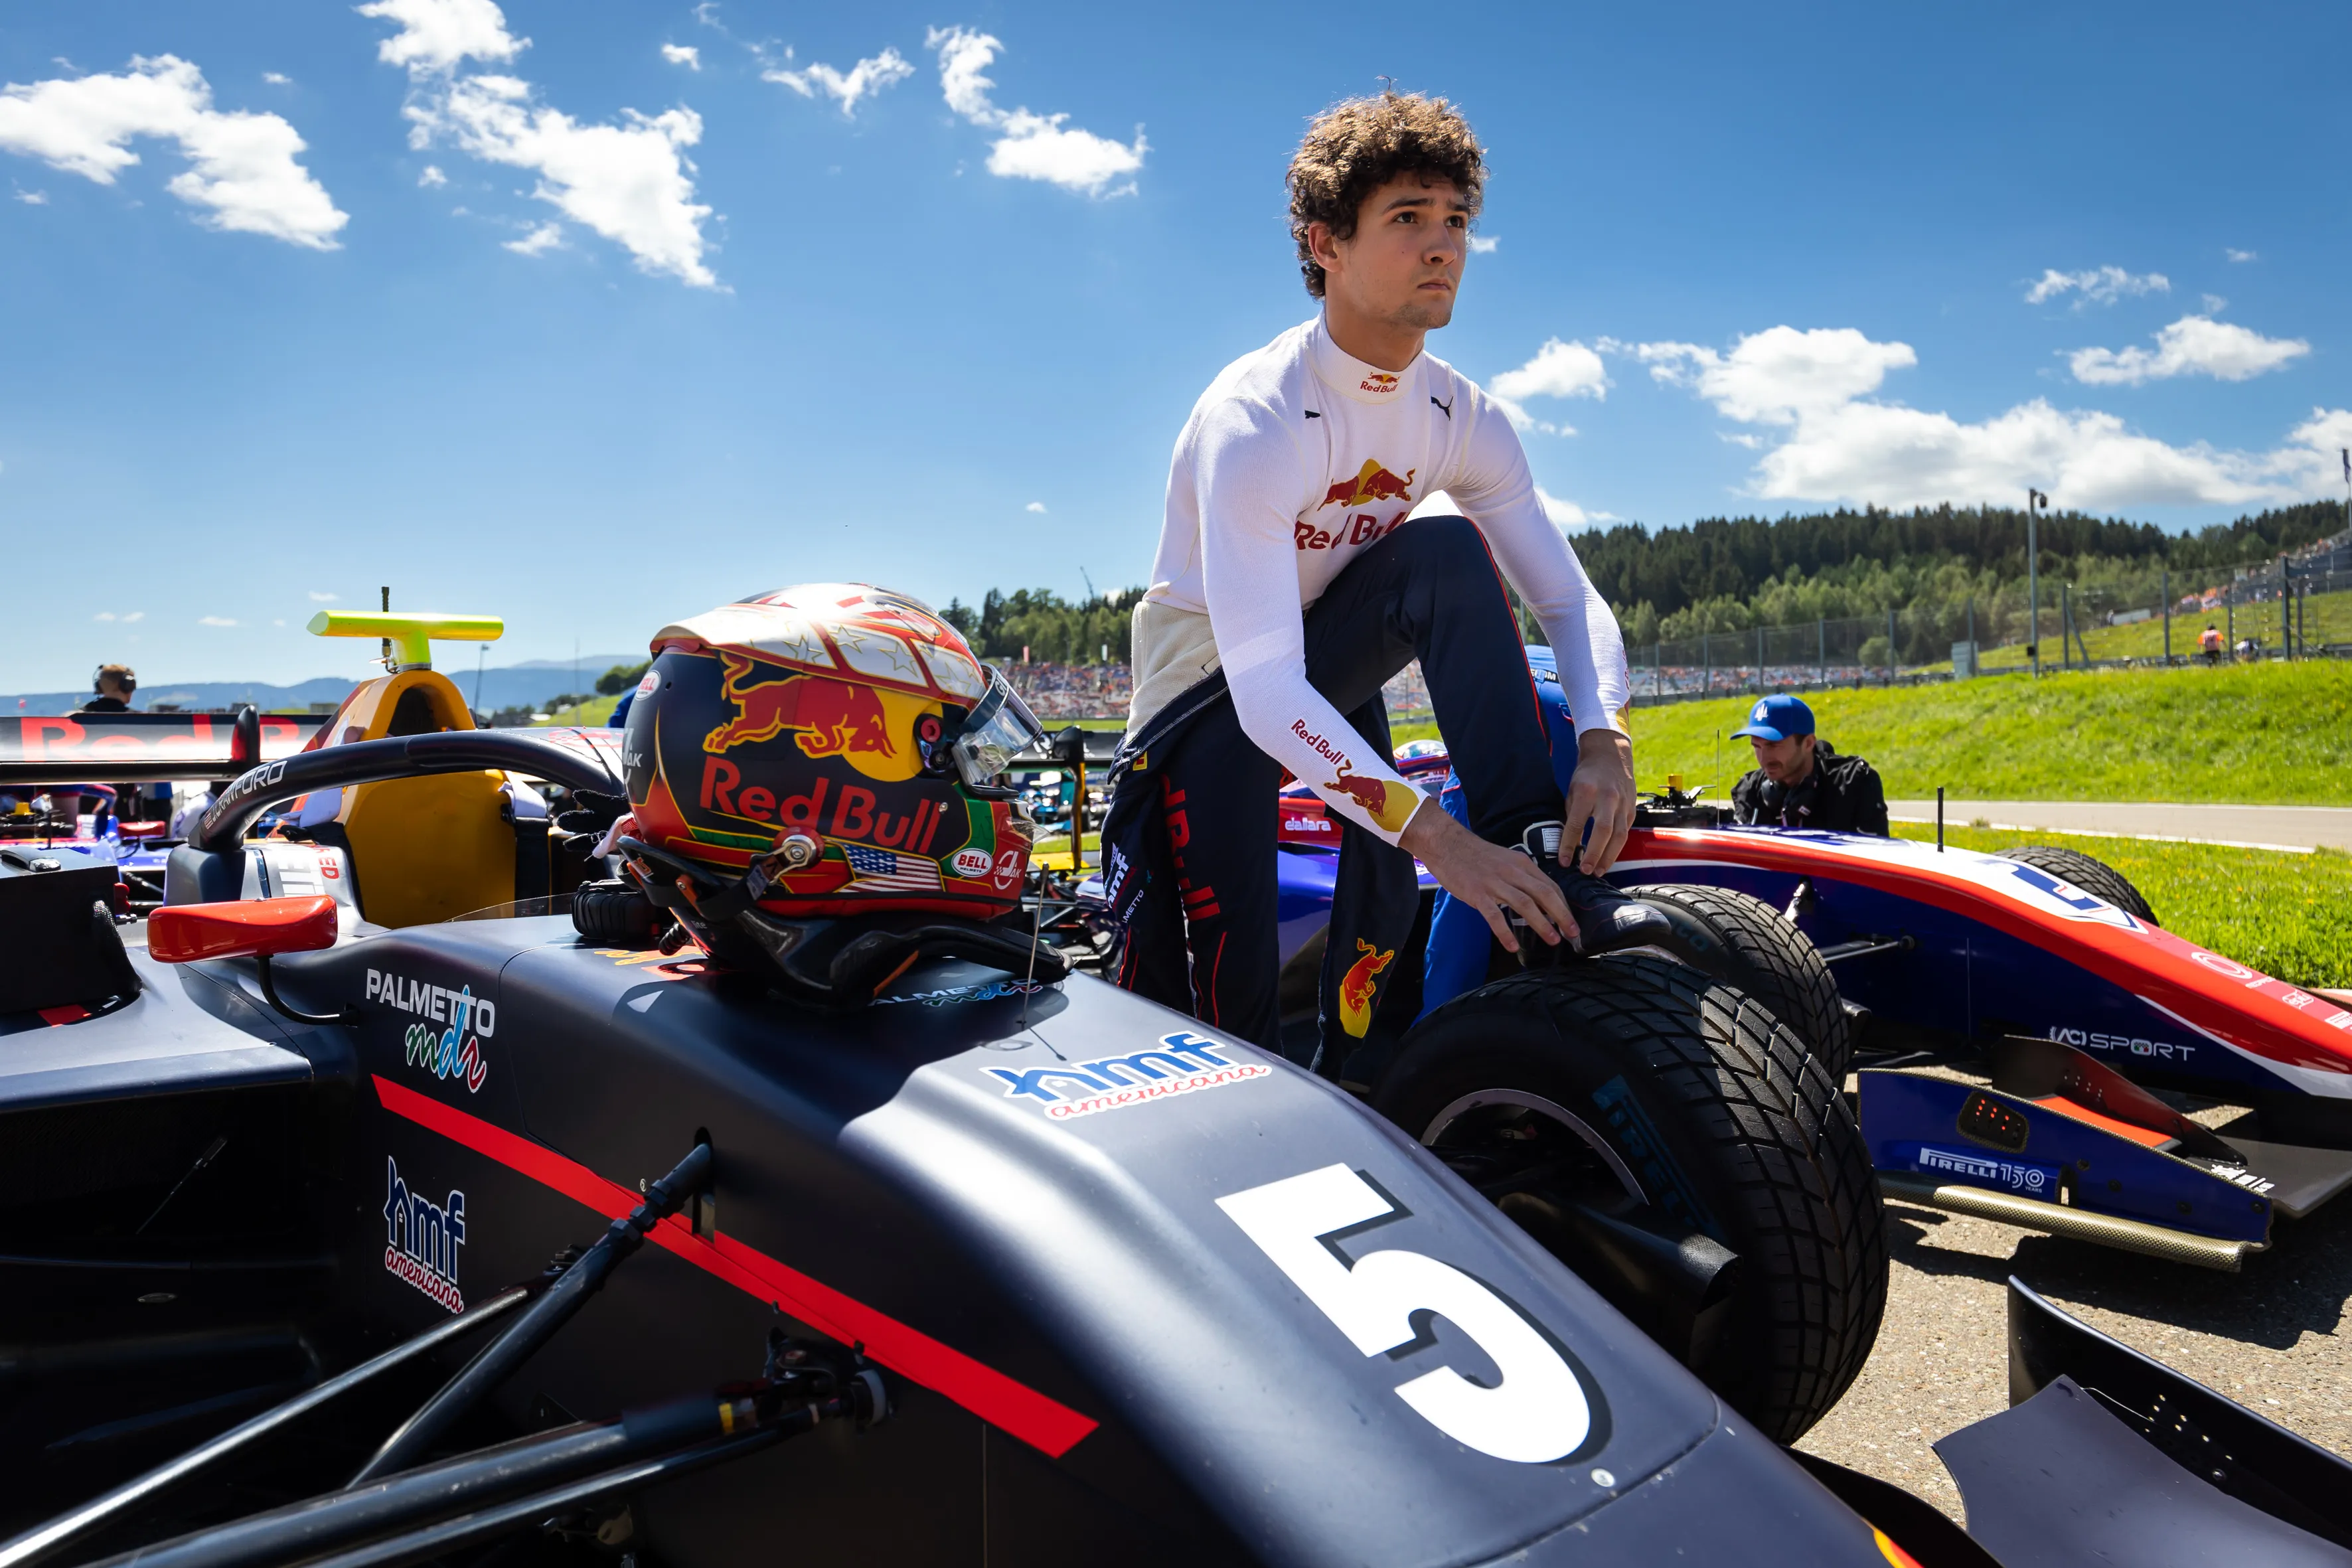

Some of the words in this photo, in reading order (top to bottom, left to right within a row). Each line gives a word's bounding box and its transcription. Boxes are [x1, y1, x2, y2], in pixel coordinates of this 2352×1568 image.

[1360, 381, 1380, 393] Red
[1381, 383, 1399, 394] Bull
[1291, 719, 1321, 747] Red
[1315, 738, 1345, 765] Bull
[700, 755, 829, 826] Red
[830, 784, 943, 854] Bull
[1285, 817, 1331, 831] dallara
[958, 854, 987, 869] BELL
[366, 968, 495, 1038] PALMETTO
[2090, 1033, 2195, 1061] SPORT
[1044, 1065, 1273, 1121] americana
[1919, 1147, 1998, 1178] PIRELLI
[2000, 1163, 2045, 1189] 150
[383, 1155, 465, 1285] hmf
[385, 1245, 464, 1314] americana
[1214, 1162, 1593, 1464] 5
